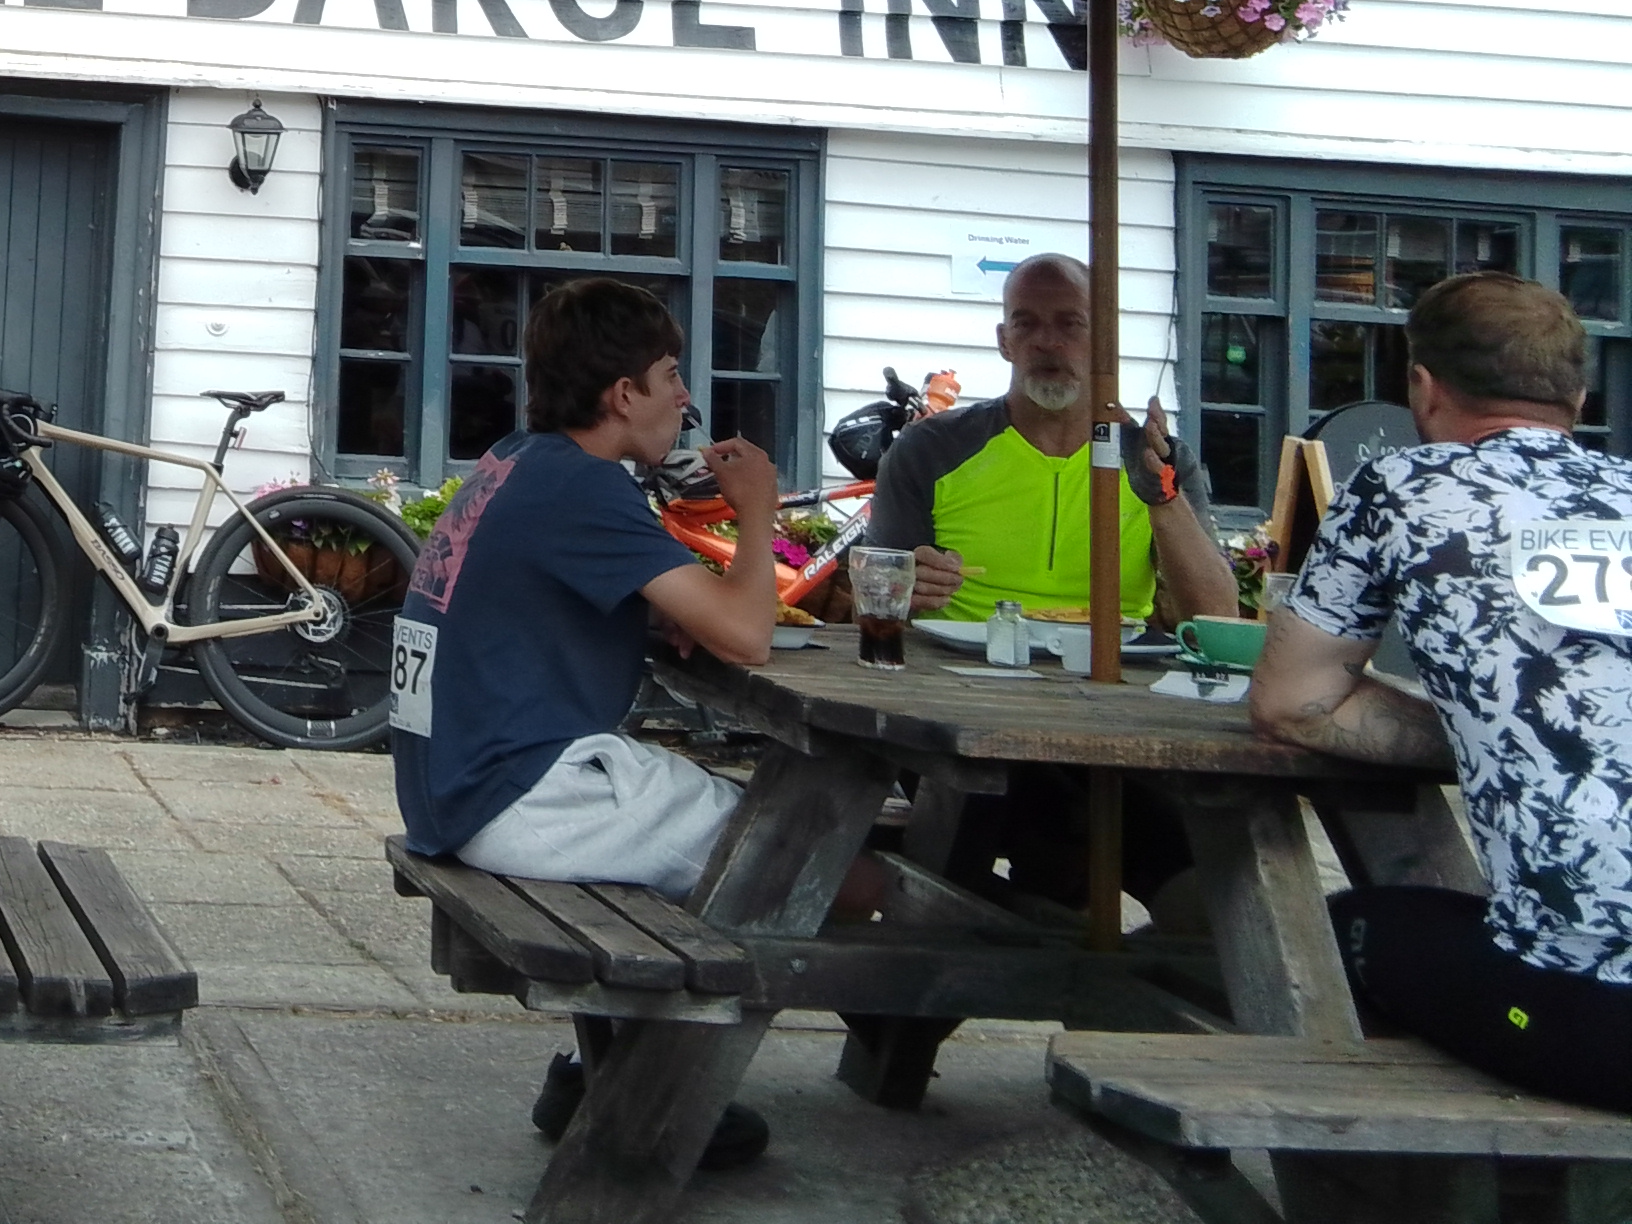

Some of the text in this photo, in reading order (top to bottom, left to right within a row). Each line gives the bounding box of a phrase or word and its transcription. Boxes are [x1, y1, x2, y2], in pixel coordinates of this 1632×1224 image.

[968, 233, 1030, 245] Drinking Water
[803, 513, 868, 580] RALEIGH
[1520, 529, 1632, 552] BIKE EV
[394, 643, 428, 695] 87
